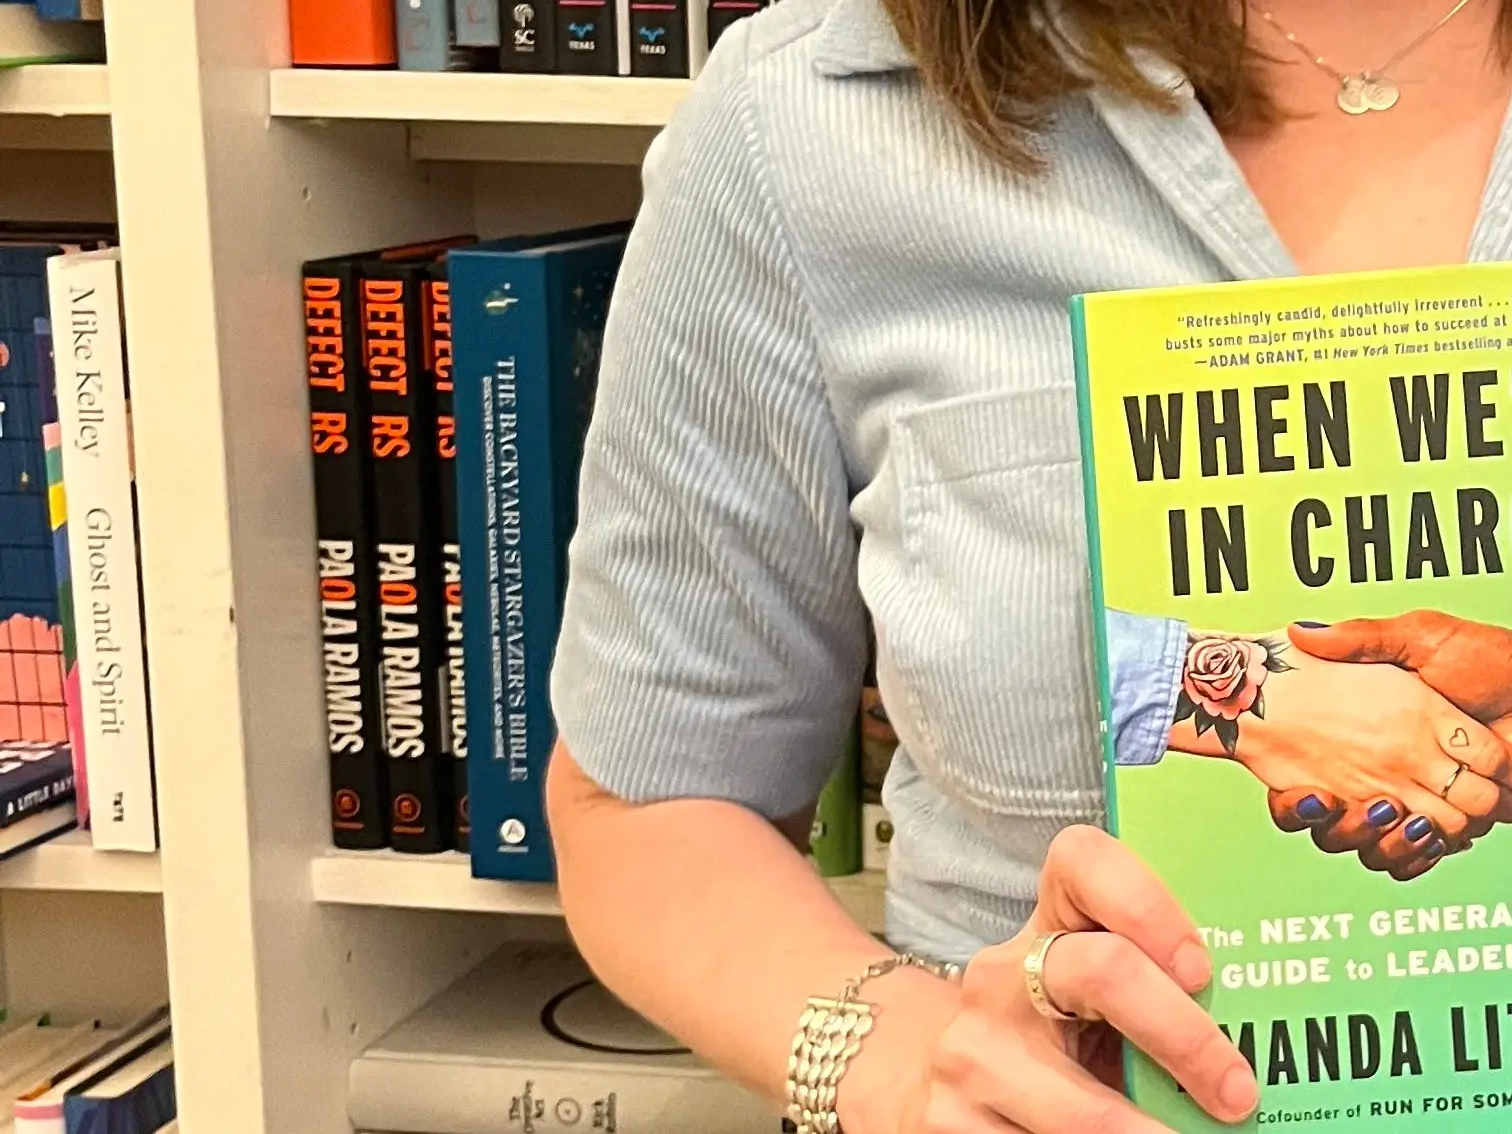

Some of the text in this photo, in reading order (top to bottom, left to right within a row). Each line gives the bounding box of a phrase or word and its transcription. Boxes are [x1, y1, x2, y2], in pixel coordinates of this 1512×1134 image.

[304, 278, 345, 392] DEFECT
[1166, 337, 1203, 351] busts
[1208, 334, 1243, 348] some
[1248, 331, 1287, 347] major
[1292, 327, 1334, 344] myths
[1339, 323, 1378, 338] about
[1383, 321, 1410, 335] how
[1416, 319, 1429, 332] to
[1434, 315, 1488, 331] succeed
[1494, 313, 1507, 327] at
[1256, 348, 1309, 365] GRANT,
[1333, 346, 1359, 359] New
[1362, 344, 1389, 357] York
[1394, 341, 1429, 355] Times
[1434, 336, 1501, 352] bestselling
[1277, 305, 1326, 321] candid,
[1331, 300, 1409, 319] delightfully
[1415, 295, 1483, 312] irreverent
[69, 286, 106, 460] Mike Kelley
[1123, 380, 1352, 482] WHEN
[496, 355, 529, 781] THE BACKYARD STARGAZER'S BIBLE
[1168, 504, 1250, 597] IN
[85, 506, 124, 738] Ghost and Spirit
[318, 540, 364, 754] PAOLA RAMOS
[1198, 927, 1244, 949] The
[1260, 913, 1354, 945] NEXT
[1220, 956, 1331, 990] GUIDE
[1345, 958, 1374, 981] to
[1180, 1009, 1423, 1093] MANDA
[1256, 1108, 1340, 1125] Cofounder
[1370, 1098, 1414, 1116] RUN
[1423, 1096, 1464, 1113] FOR
